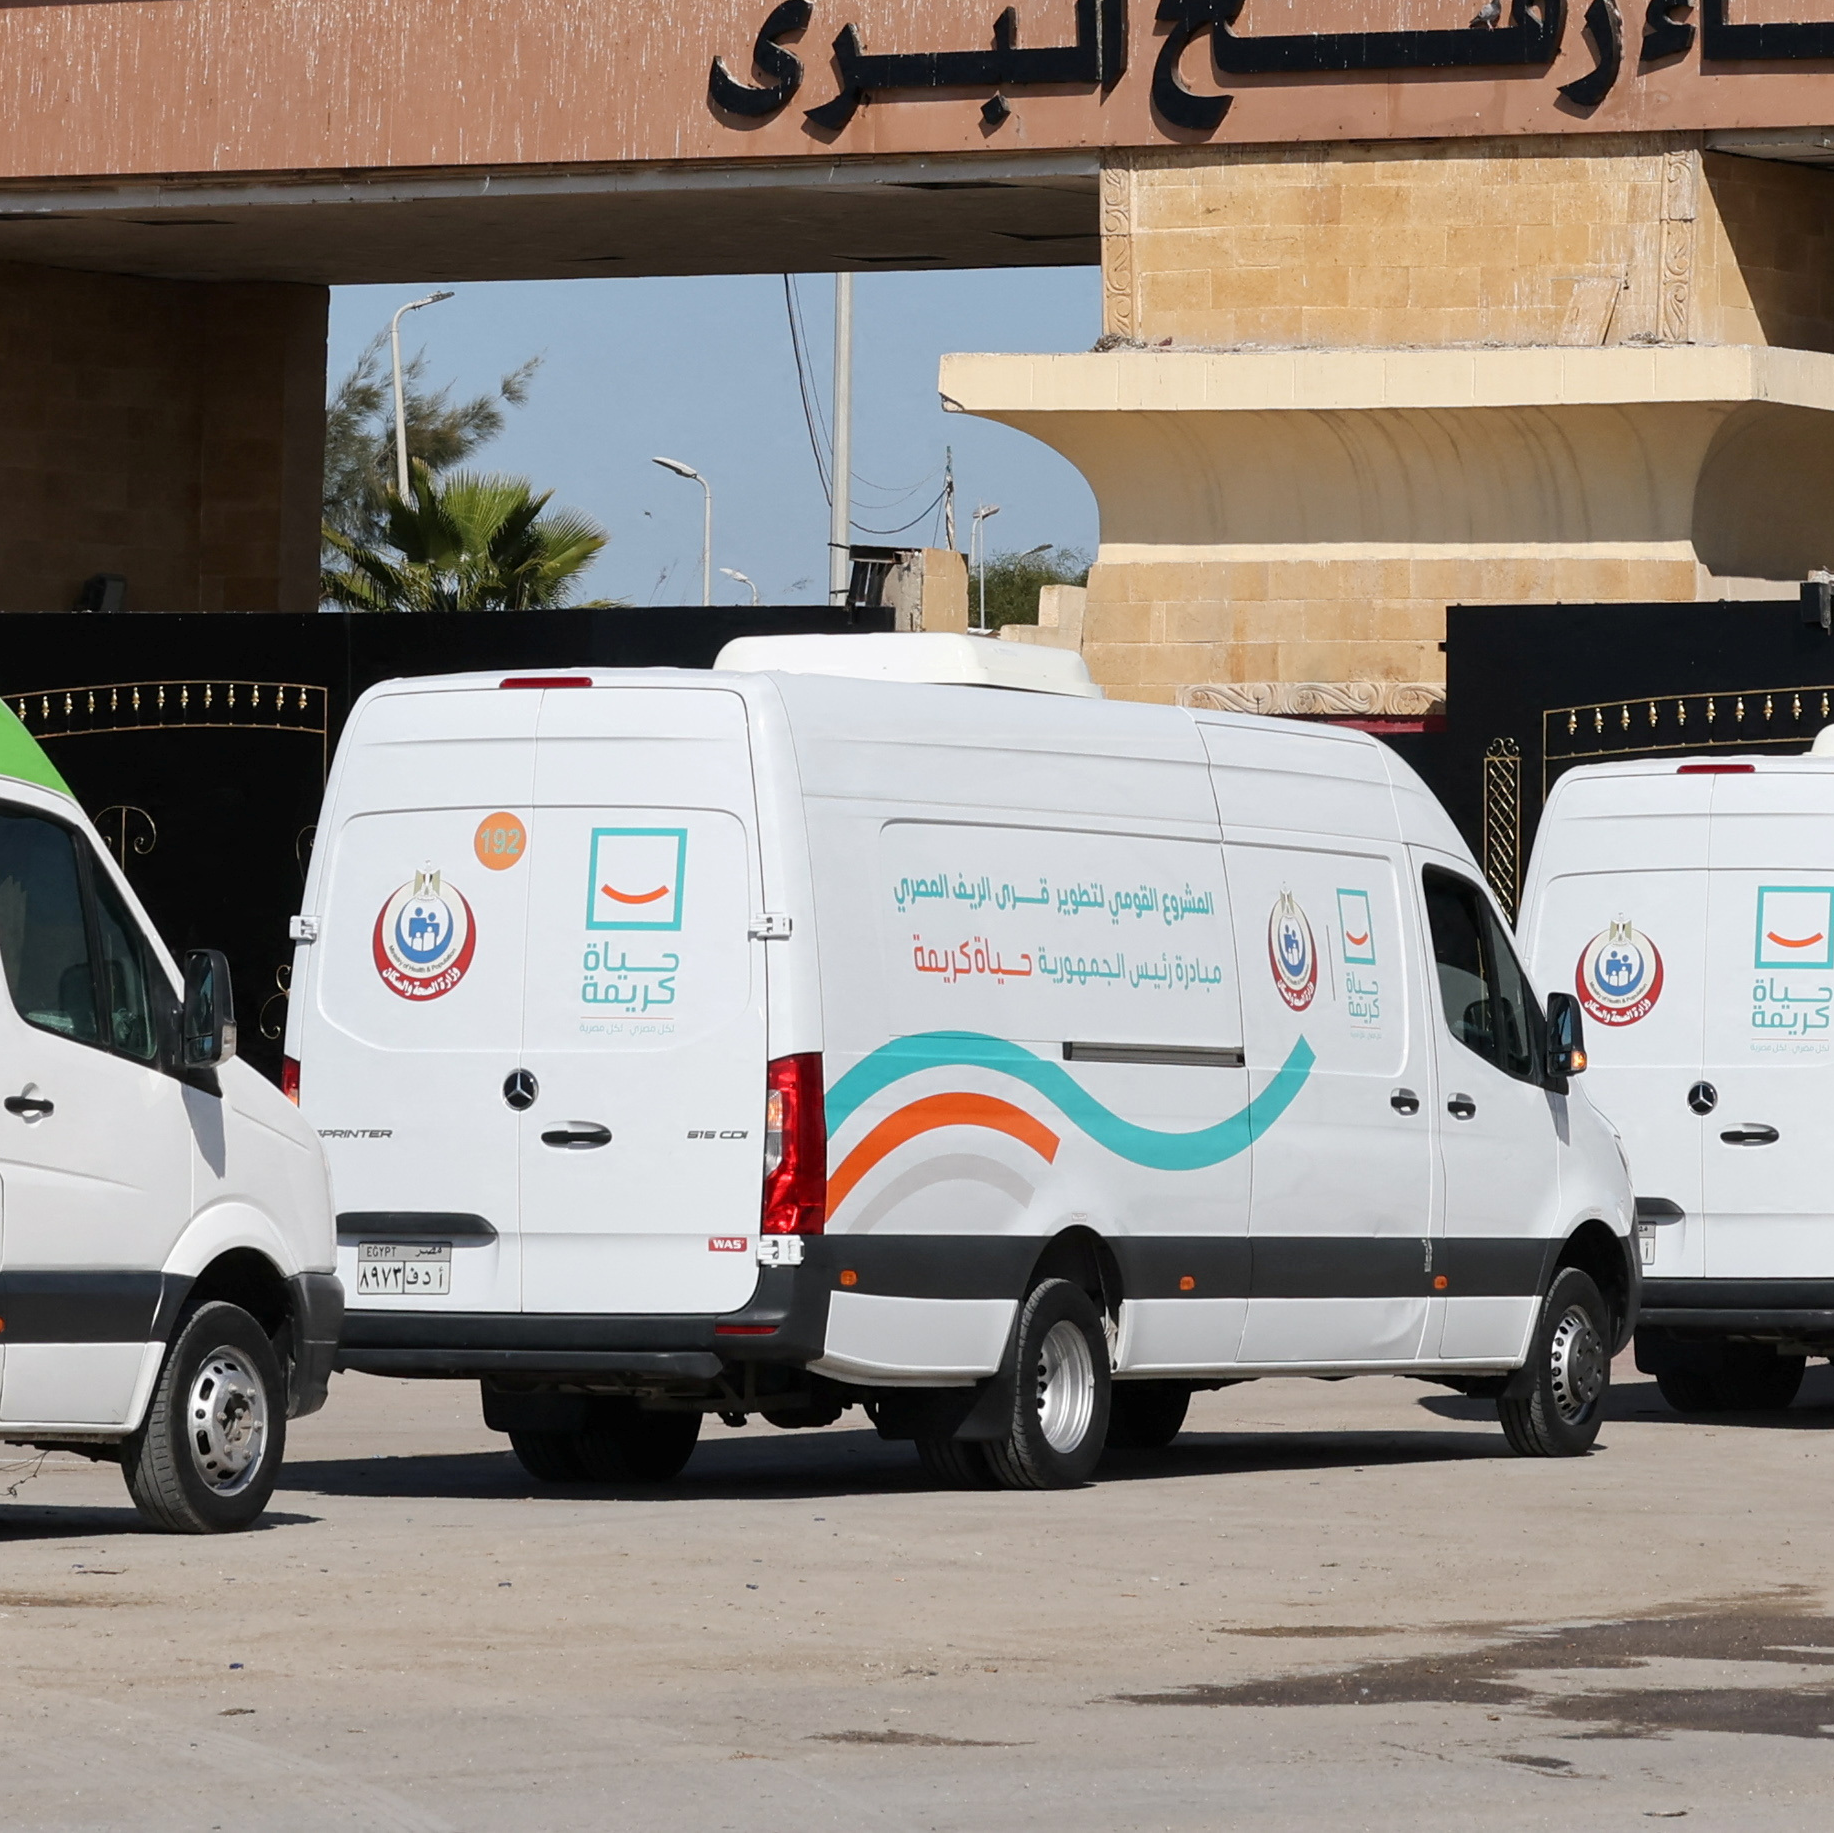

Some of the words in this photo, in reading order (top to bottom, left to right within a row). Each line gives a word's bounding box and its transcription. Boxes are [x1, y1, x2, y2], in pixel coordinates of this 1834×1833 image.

[480, 828, 522, 855] 192
[893, 873, 949, 913] المصري
[952, 872, 991, 910] الريف
[1057, 882, 1105, 916] لتطوير
[1108, 884, 1159, 926] القومي
[1162, 882, 1215, 926] المشروع
[388, 945, 403, 968] Ministry
[408, 964, 427, 973] Health
[431, 947, 457, 972] Population
[583, 941, 680, 981] حياة
[912, 934, 972, 984] كريمة
[973, 935, 1033, 985] حياة
[1038, 946, 1126, 986] الجمهورية
[1129, 952, 1173, 989] رئيس
[1175, 954, 1222, 993] مبادرة
[412, 980, 439, 996] الصحة
[439, 967, 461, 991] وزارة
[581, 975, 676, 1013] كريمة
[1346, 971, 1379, 1000] حياة
[1752, 977, 1833, 1010] حياة
[1348, 996, 1380, 1024] كريمة
[1751, 1005, 1830, 1036] كريمة
[719, 1130, 749, 1140] CDI
[366, 1246, 397, 1258] EGYPT
[415, 1247, 443, 1258] مصر
[359, 1265, 402, 1288] ٨٩٧٣
